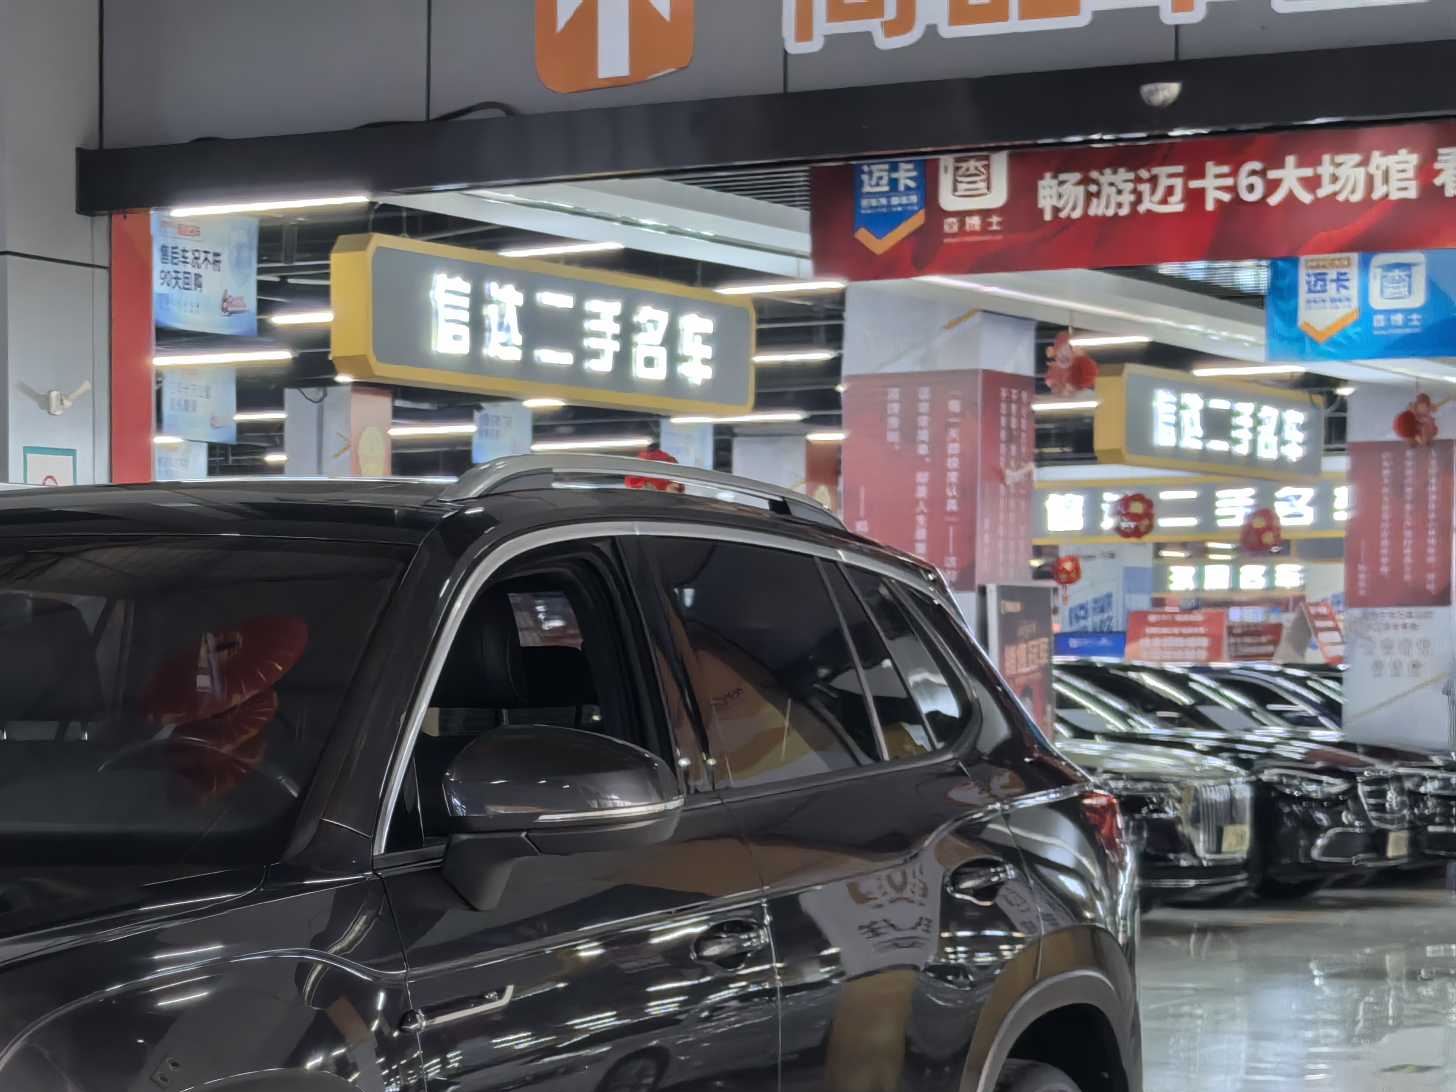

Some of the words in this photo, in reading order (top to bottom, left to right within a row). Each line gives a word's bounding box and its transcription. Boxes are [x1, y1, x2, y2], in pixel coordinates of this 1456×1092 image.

[861, 163, 918, 193] 迈卡
[1037, 148, 1420, 221] 畅游迈卡6大场馆
[430, 272, 715, 386] 信达二手名车
